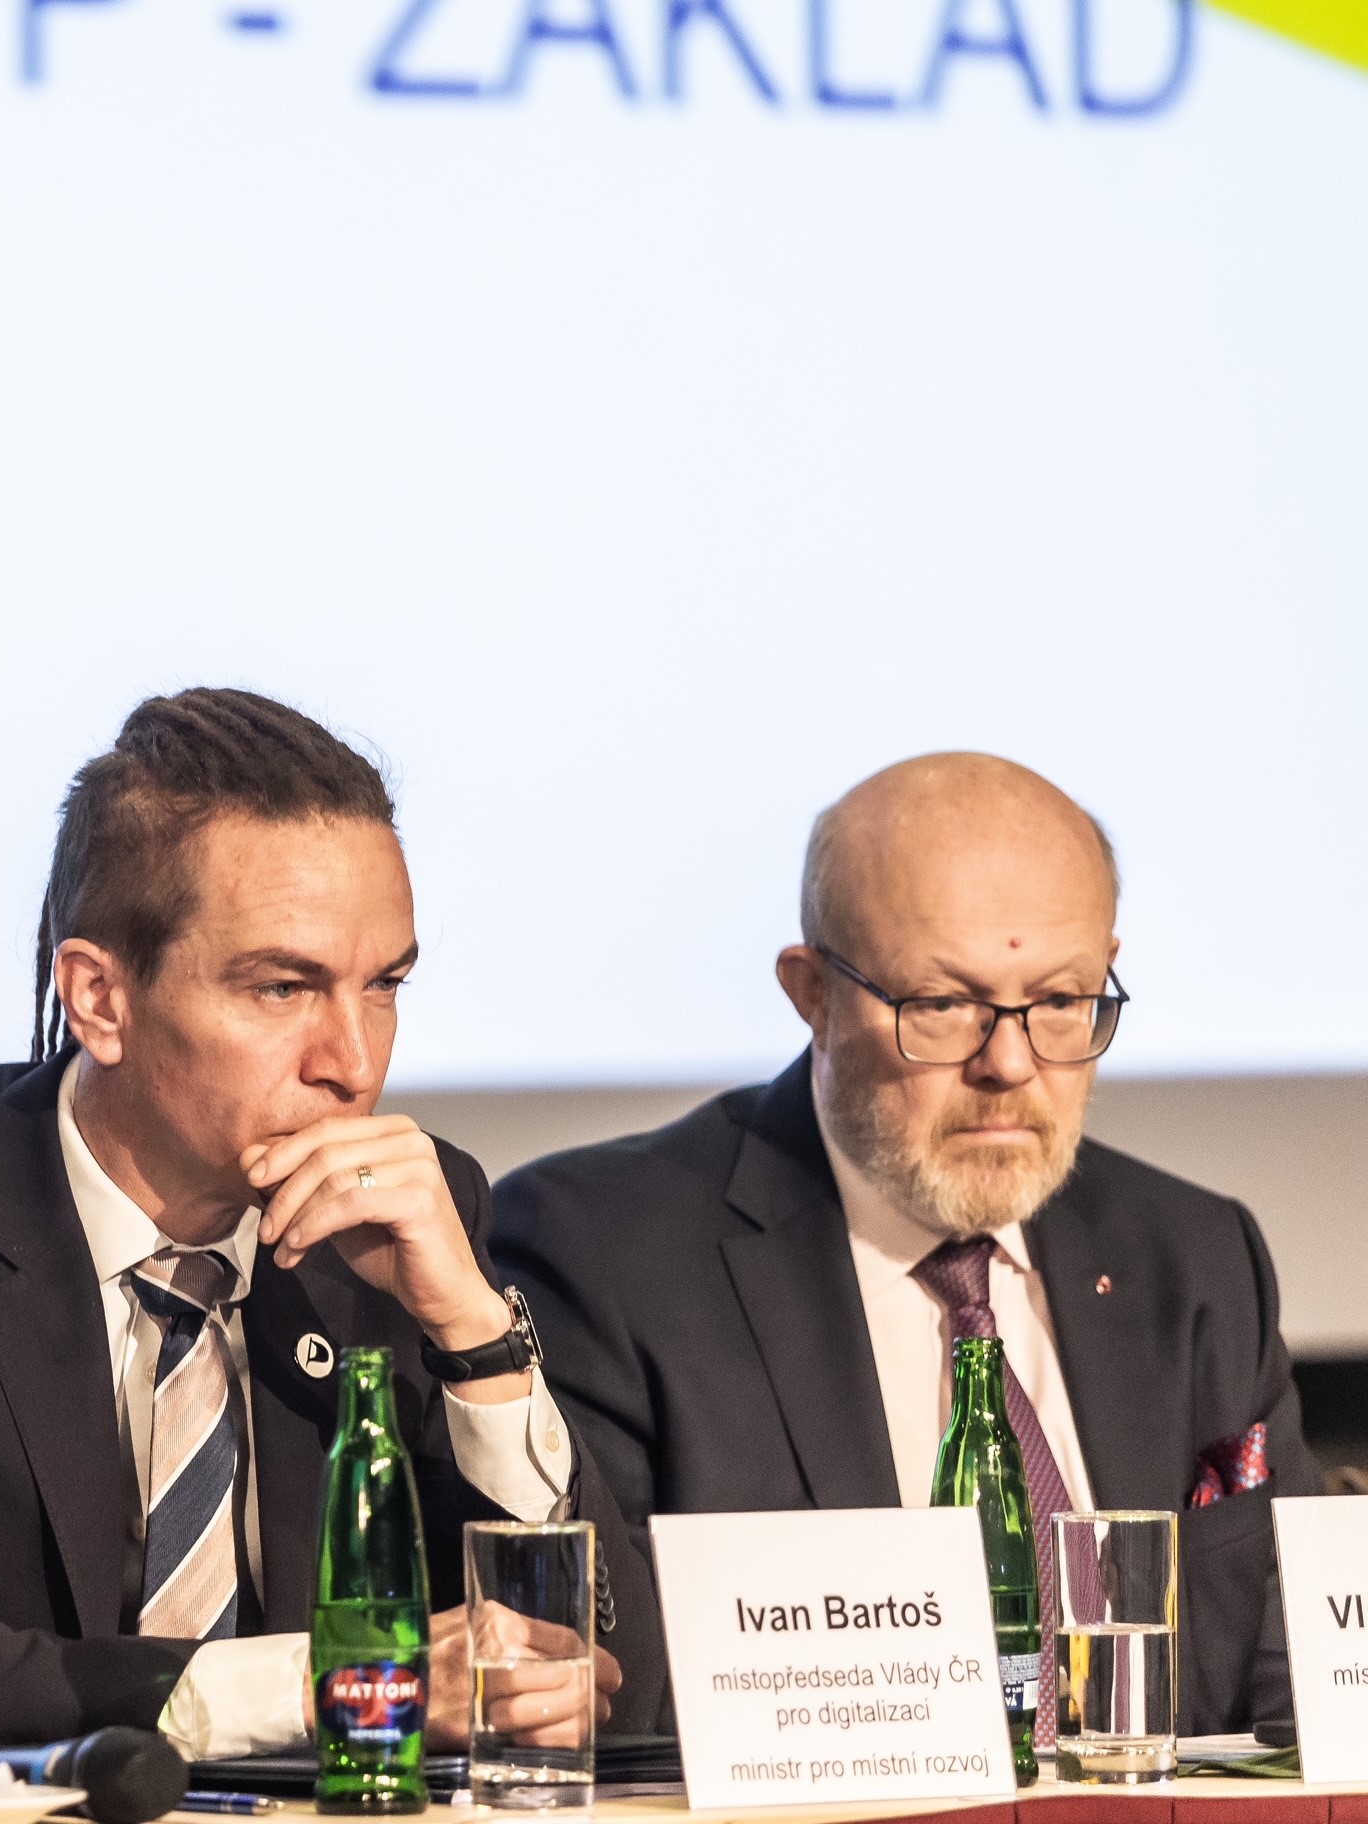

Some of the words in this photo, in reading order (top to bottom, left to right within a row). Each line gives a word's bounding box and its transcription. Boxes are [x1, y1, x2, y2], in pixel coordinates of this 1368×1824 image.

[736, 1597, 812, 1633] Ivan
[823, 1591, 943, 1631] Bartoš
[1327, 1594, 1368, 1630] Vl
[712, 1664, 875, 1696] místopředseda
[879, 1660, 941, 1690] Vlády
[948, 1654, 984, 1684] ČR
[776, 1706, 812, 1732] pro
[818, 1697, 930, 1730] digitalizaci
[730, 1758, 802, 1782] ministr
[809, 1759, 845, 1784] pro
[852, 1751, 918, 1777] místní
[925, 1748, 990, 1778] rozvoj
